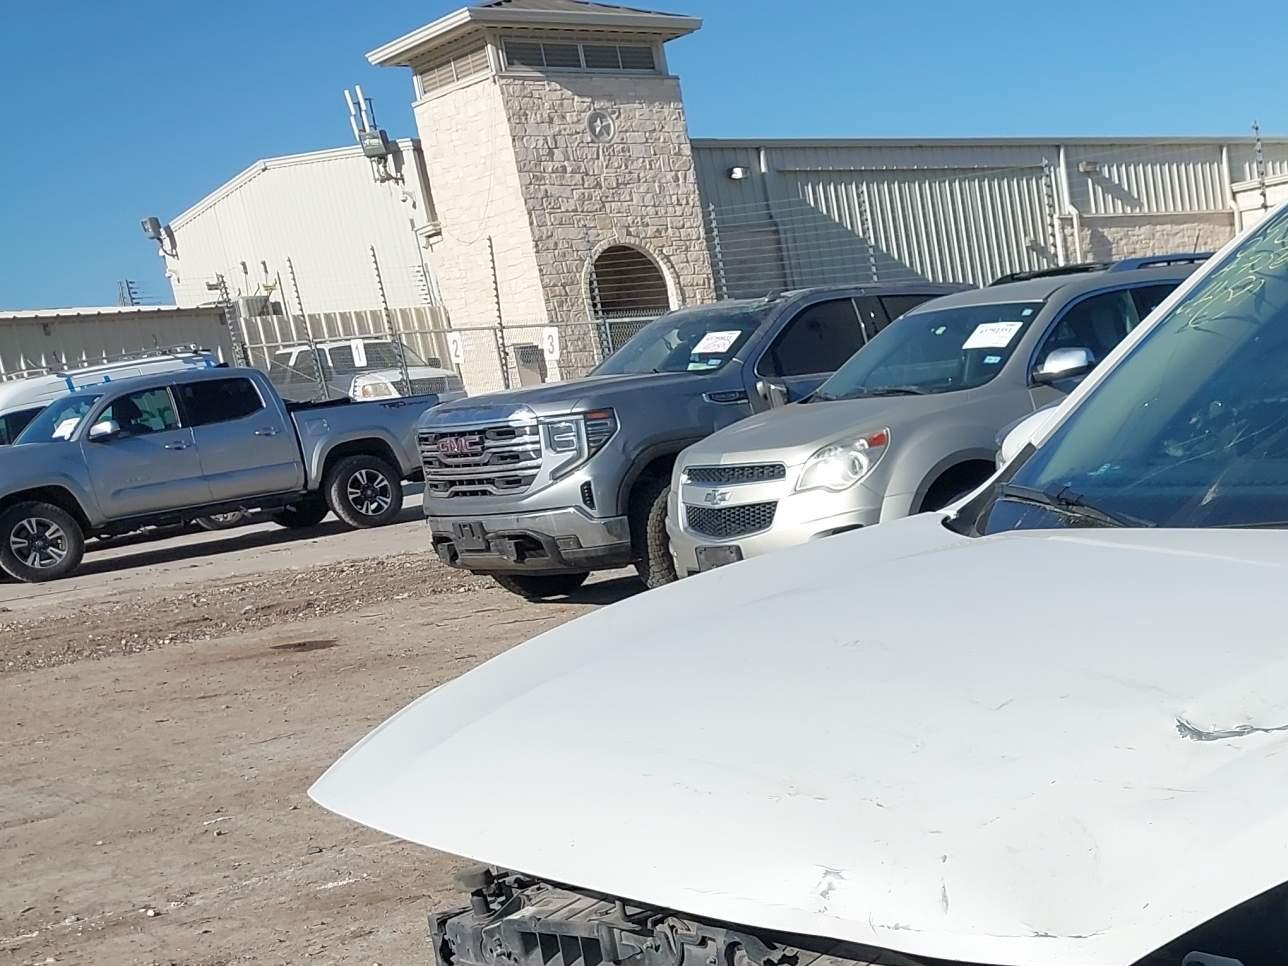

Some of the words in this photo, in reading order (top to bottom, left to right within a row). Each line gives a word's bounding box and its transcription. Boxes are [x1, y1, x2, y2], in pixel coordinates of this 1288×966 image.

[452, 339, 460, 358] 2
[547, 334, 555, 354] 3
[438, 435, 482, 454] GMC
